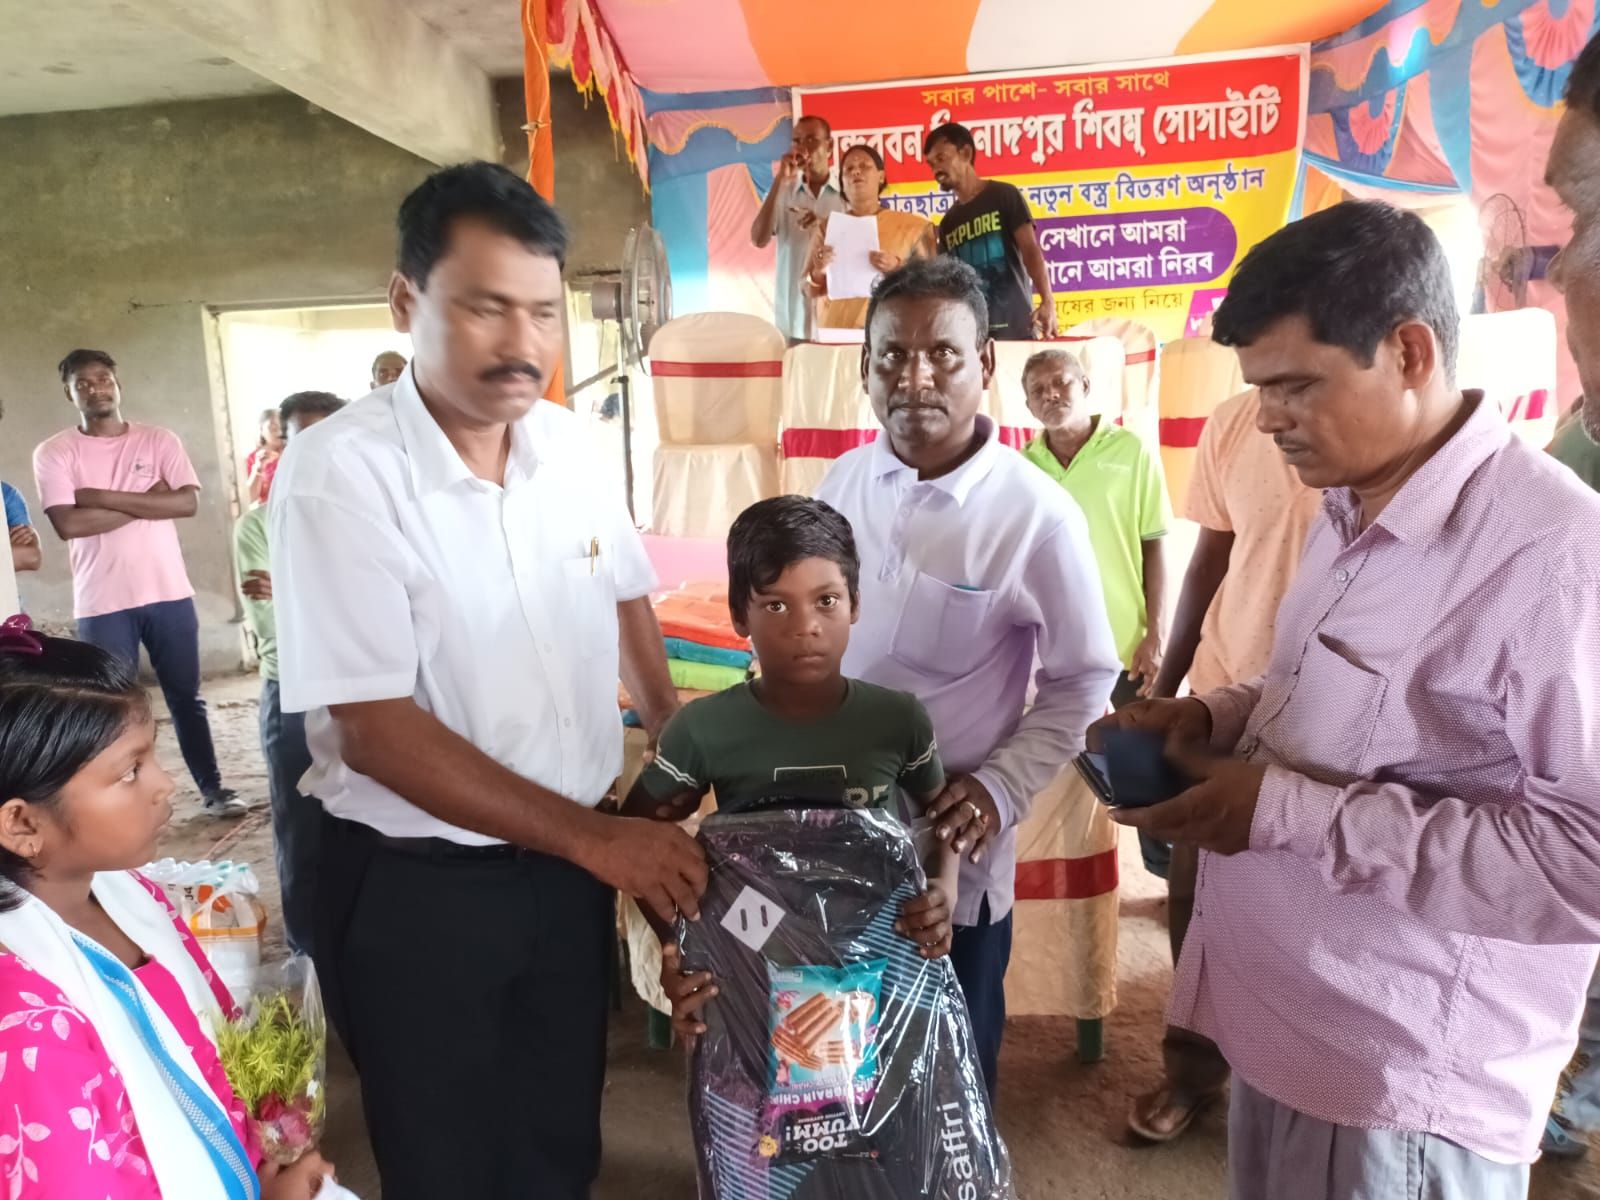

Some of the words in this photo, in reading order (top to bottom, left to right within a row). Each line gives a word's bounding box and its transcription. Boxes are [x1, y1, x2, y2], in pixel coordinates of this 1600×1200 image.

[920, 86, 975, 107] সবার
[1054, 76, 1109, 97] সবার
[1115, 70, 1170, 91] সাথে
[1153, 84, 1281, 145] সোসাইটি
[1028, 183, 1073, 212] নতুন
[1080, 181, 1112, 208] বস্ত্র
[1115, 172, 1181, 201] বিতরণ
[945, 210, 1002, 251] EXPLORE
[1120, 216, 1188, 244] আমরা
[1086, 253, 1154, 281] আমরা
[1158, 246, 1214, 278] নিরব
[785, 1118, 861, 1141] YUMM!
[802, 1133, 848, 1152] TOO
